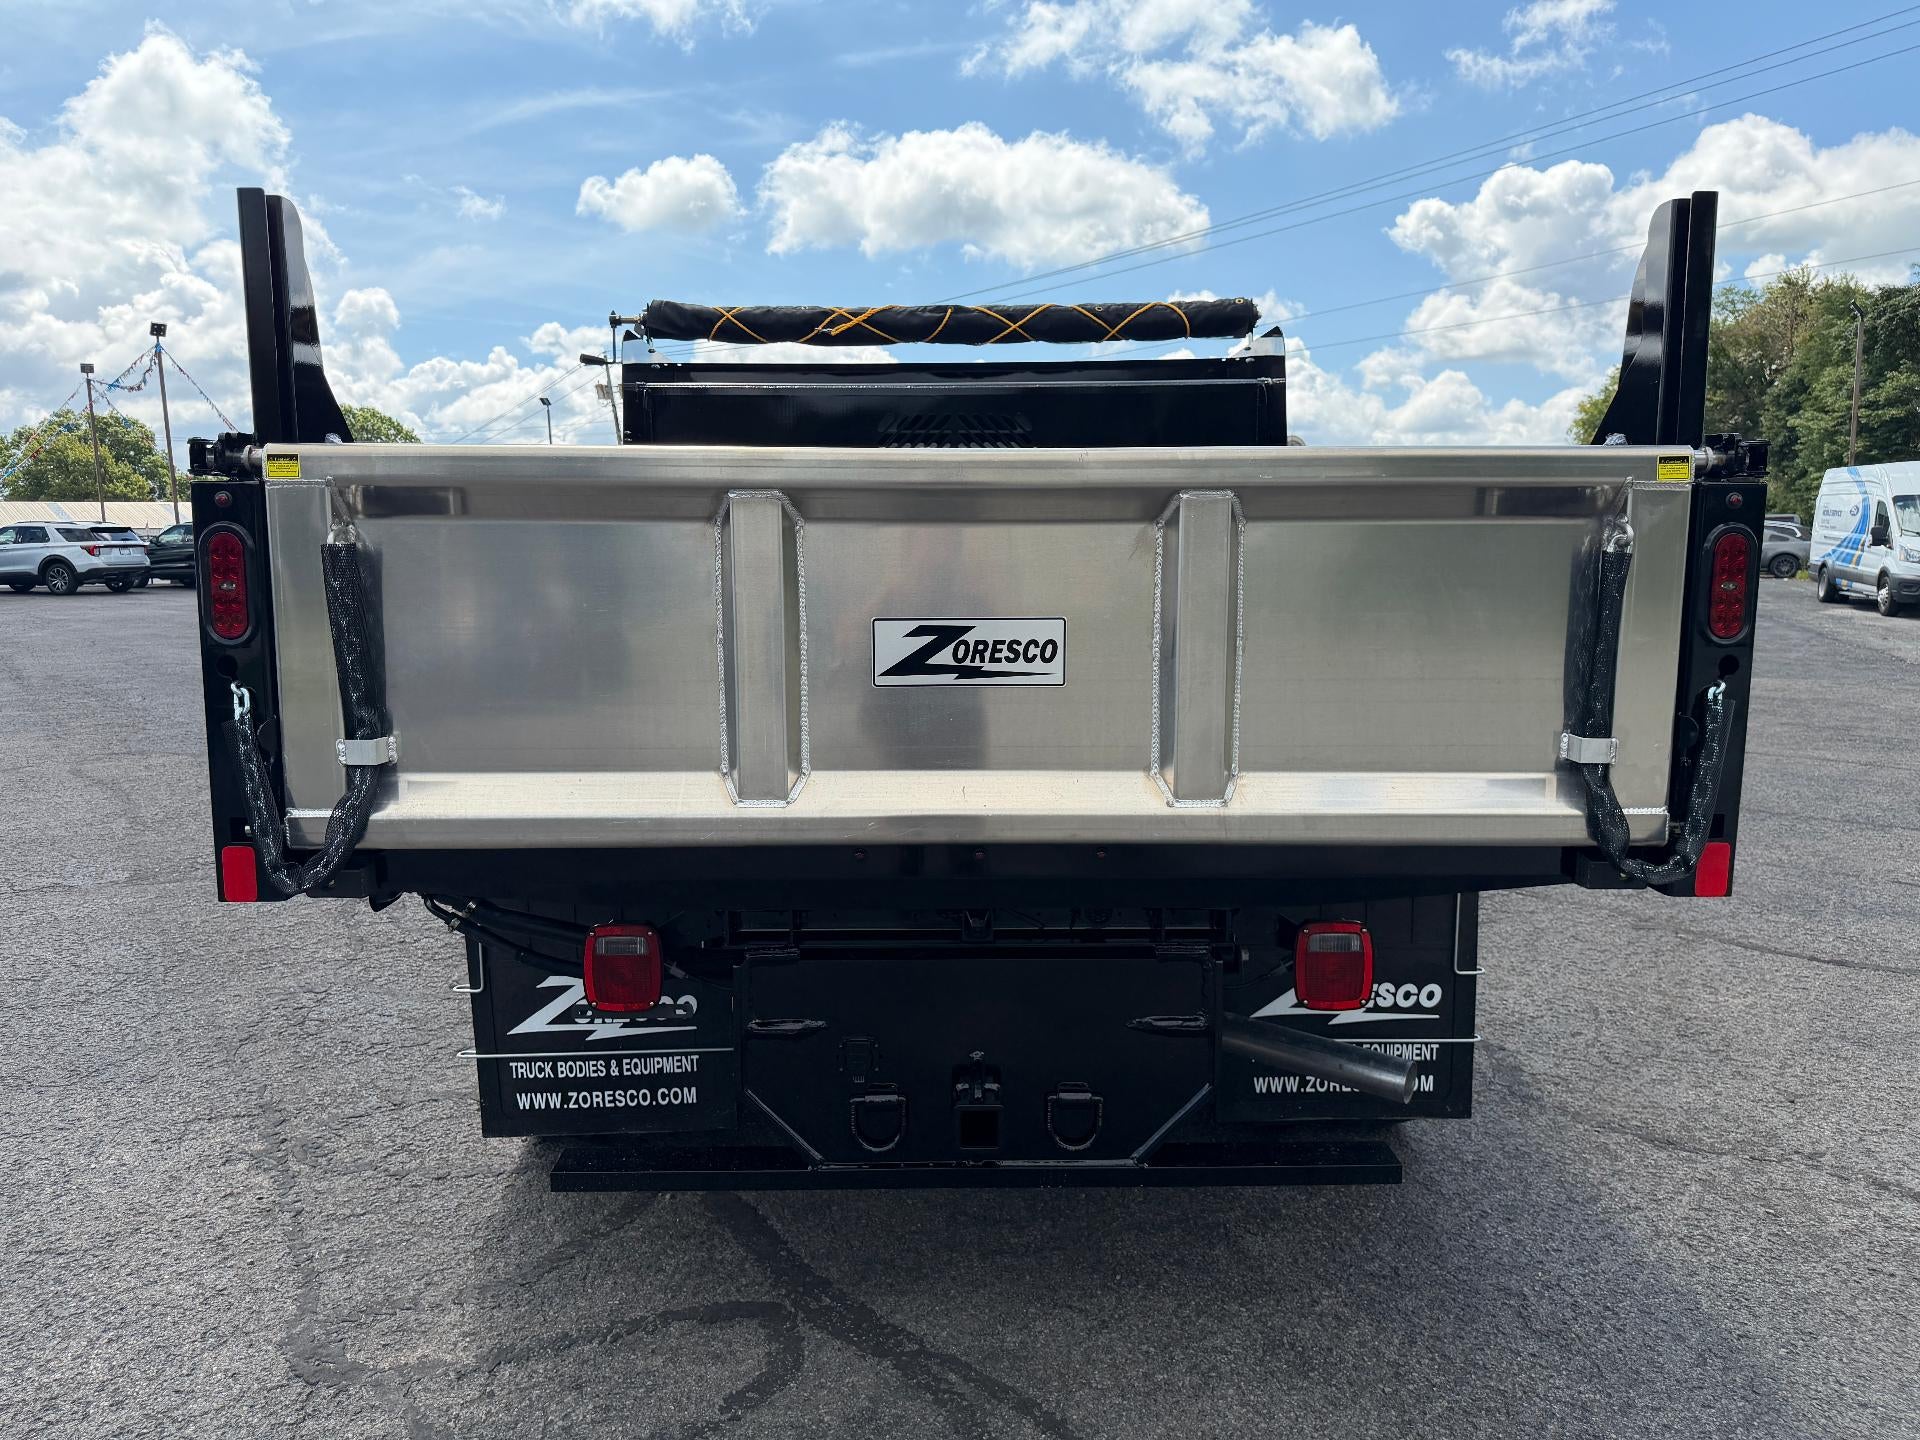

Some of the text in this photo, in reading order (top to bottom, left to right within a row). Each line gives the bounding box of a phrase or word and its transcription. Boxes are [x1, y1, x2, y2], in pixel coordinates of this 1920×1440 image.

[877, 624, 1059, 681] ZORESCO
[509, 1055, 700, 1079] TRUCK BODIES & EQUIPMENT
[516, 1086, 698, 1110] WWW.ZORESCO.COM
